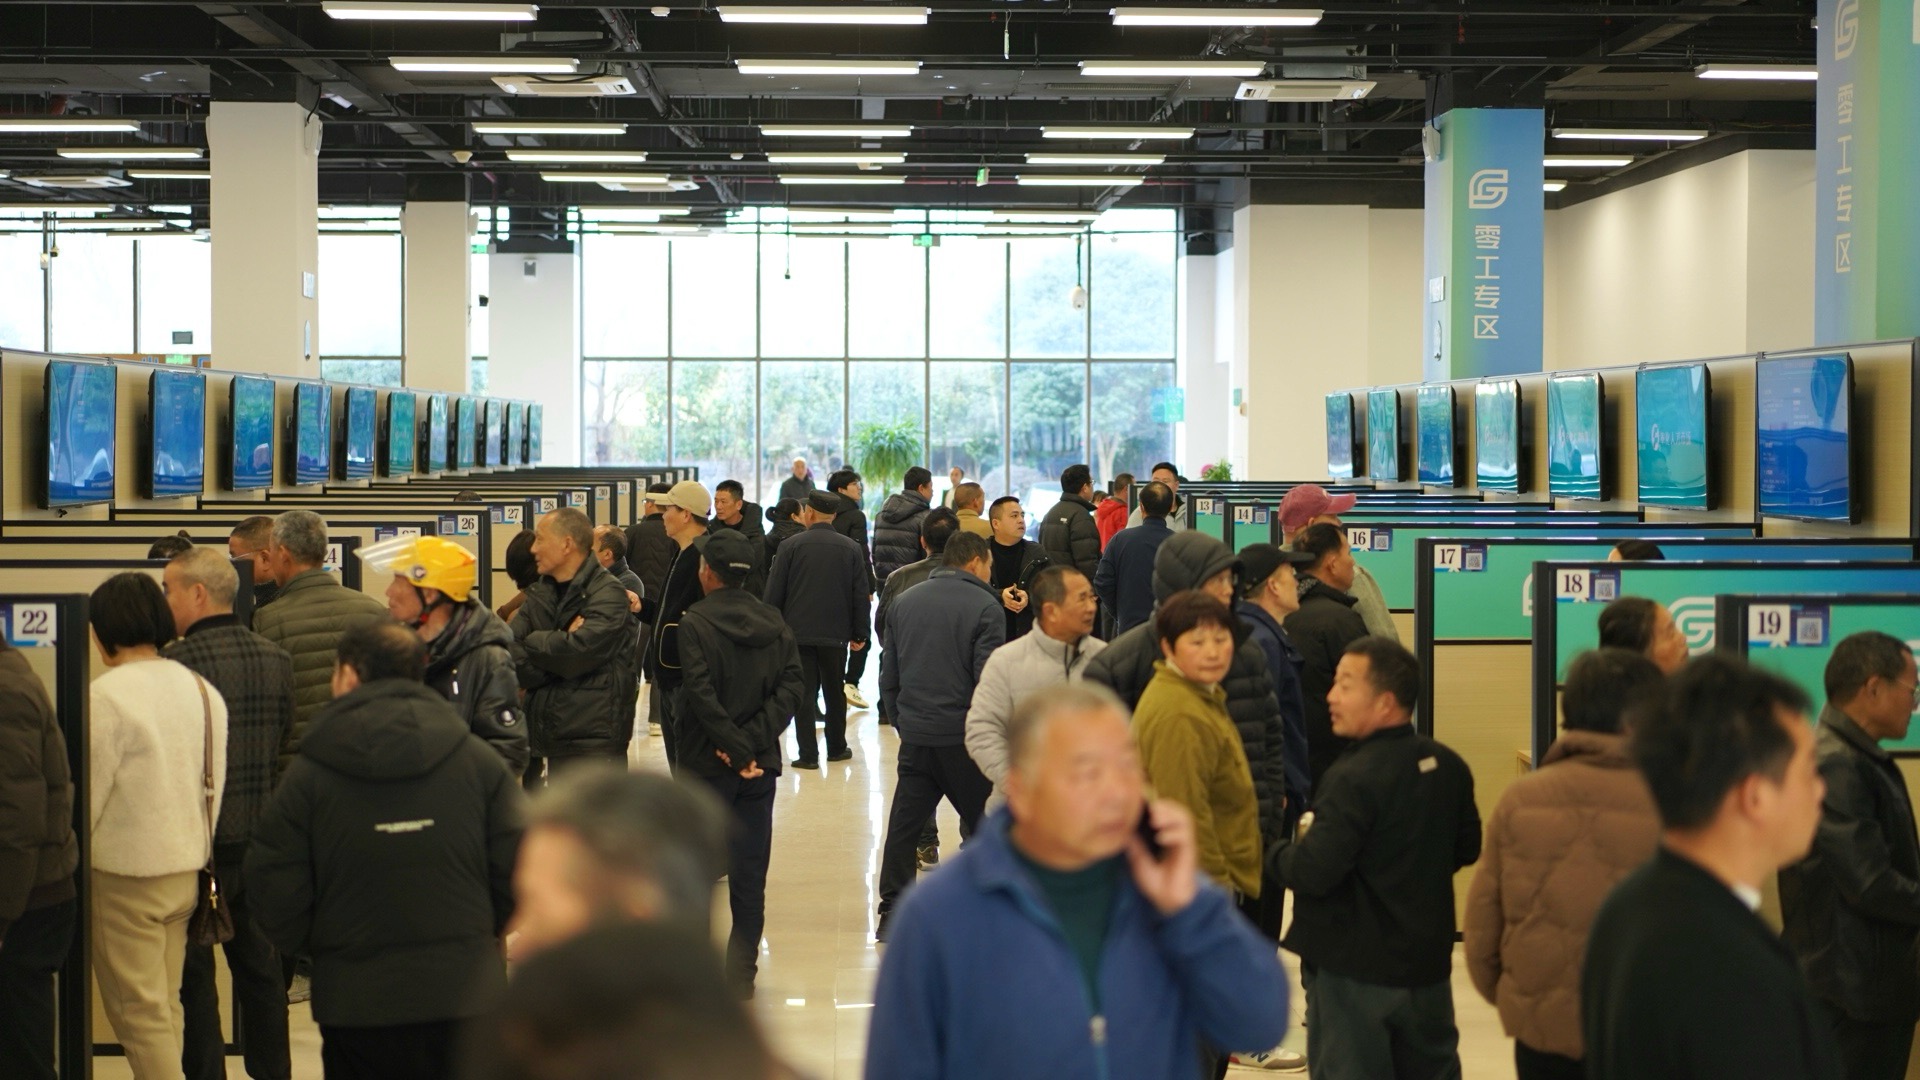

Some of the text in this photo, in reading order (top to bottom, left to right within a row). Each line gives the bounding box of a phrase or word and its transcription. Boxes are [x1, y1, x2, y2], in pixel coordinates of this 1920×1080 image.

[1836, 82, 1854, 273] 零工专区
[1474, 224, 1501, 339] 零工专区
[574, 493, 585, 503] 29
[598, 488, 608, 497] 30
[543, 500, 555, 511] 28
[1200, 500, 1210, 511] 13
[507, 508, 519, 520] 27
[1238, 508, 1249, 520] 14
[461, 517, 475, 530] 26
[1352, 531, 1366, 545] 16
[323, 547, 337, 564] 4
[1440, 548, 1456, 564] 17
[1563, 573, 1583, 593] 18
[22, 609, 48, 634] 22
[1757, 610, 1781, 636] 19
